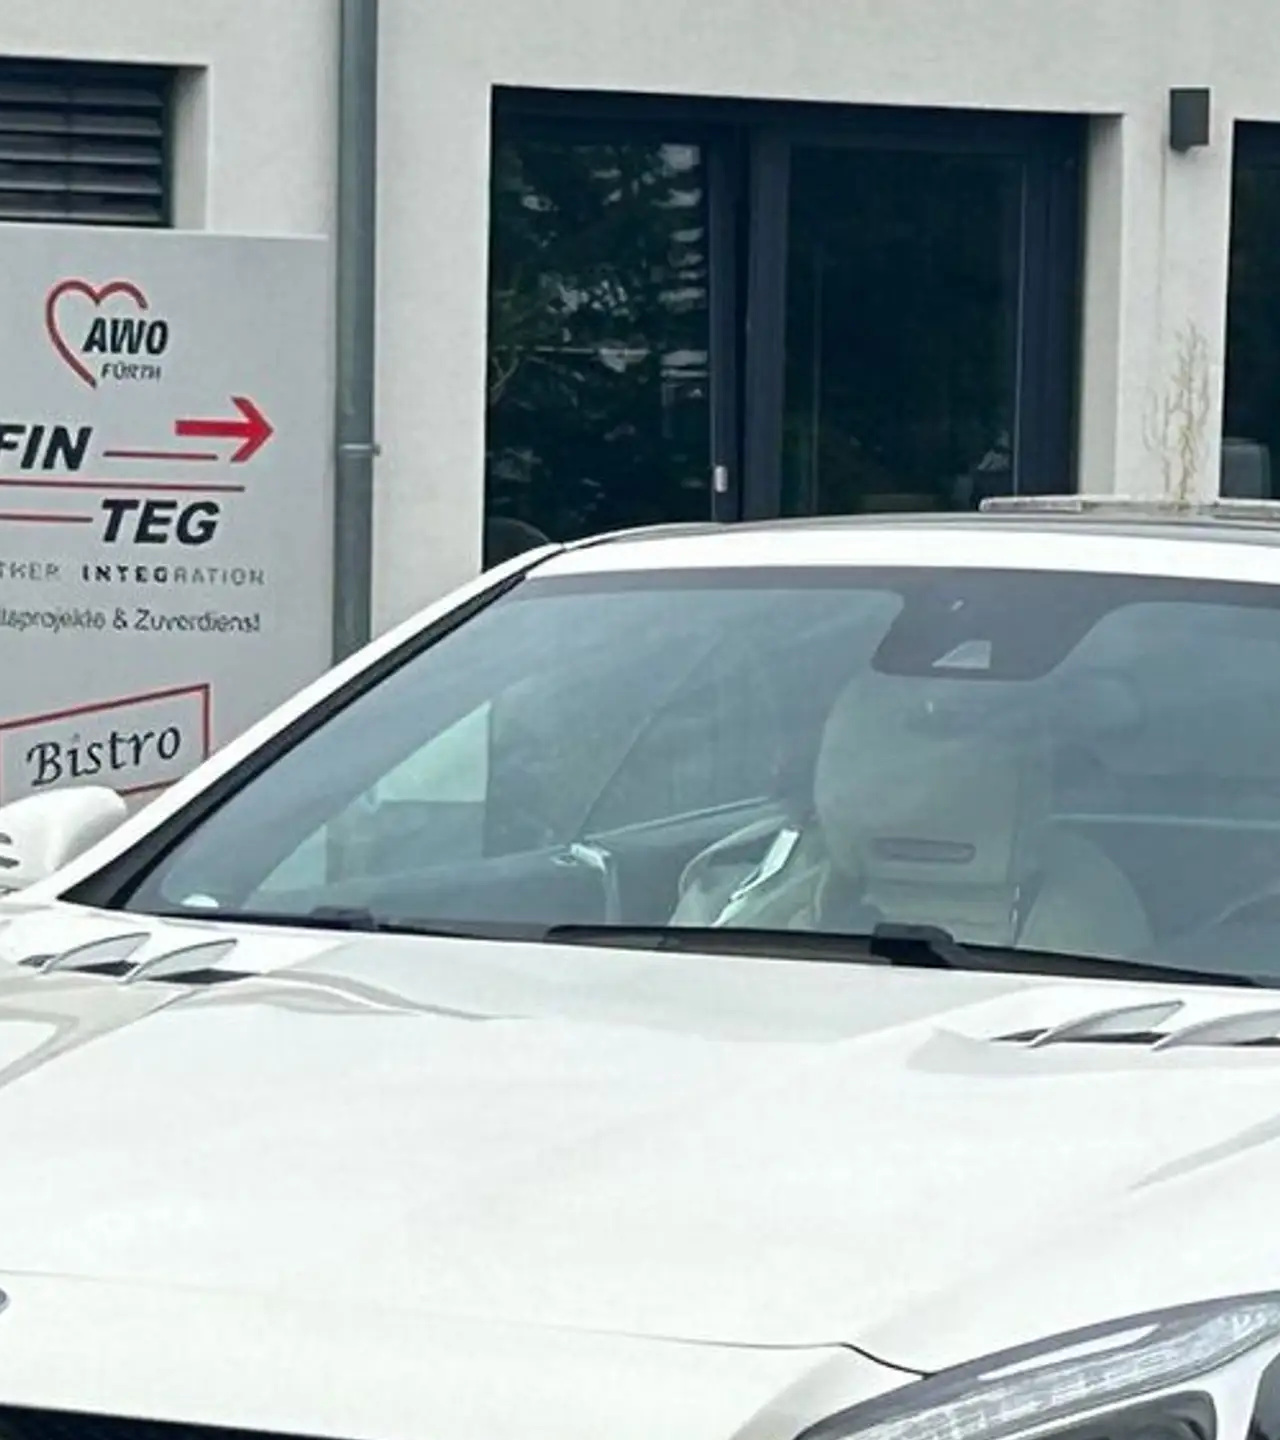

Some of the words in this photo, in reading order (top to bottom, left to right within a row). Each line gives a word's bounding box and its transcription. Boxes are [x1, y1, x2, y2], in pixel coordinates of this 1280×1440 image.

[82, 317, 169, 355] AWO
[101, 498, 220, 546] TEG
[81, 564, 265, 586] INTEGRATION
[112, 607, 129, 631] &
[133, 607, 261, 634] Zuverdienst
[25, 725, 182, 787] Bistro
